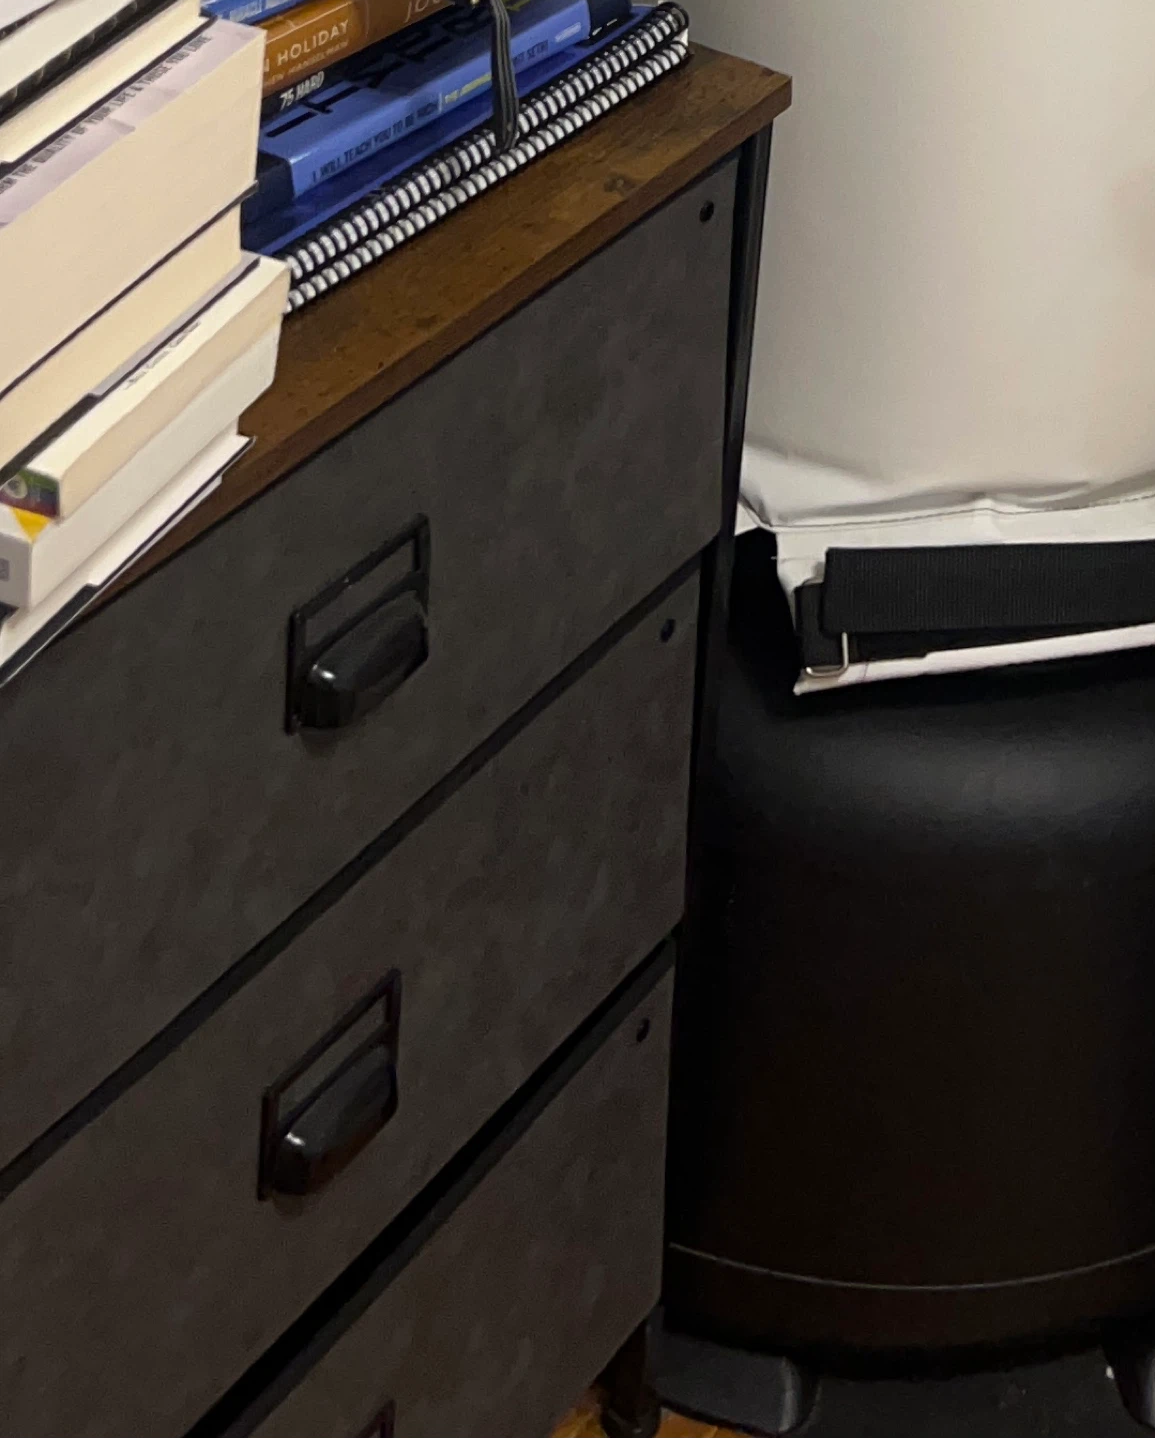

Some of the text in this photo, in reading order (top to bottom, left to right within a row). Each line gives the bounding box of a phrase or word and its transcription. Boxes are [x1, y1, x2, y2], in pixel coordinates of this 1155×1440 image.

[277, 19, 351, 67] HOLIDAY
[295, 71, 326, 101] HARD
[341, 141, 372, 167] TEACH
